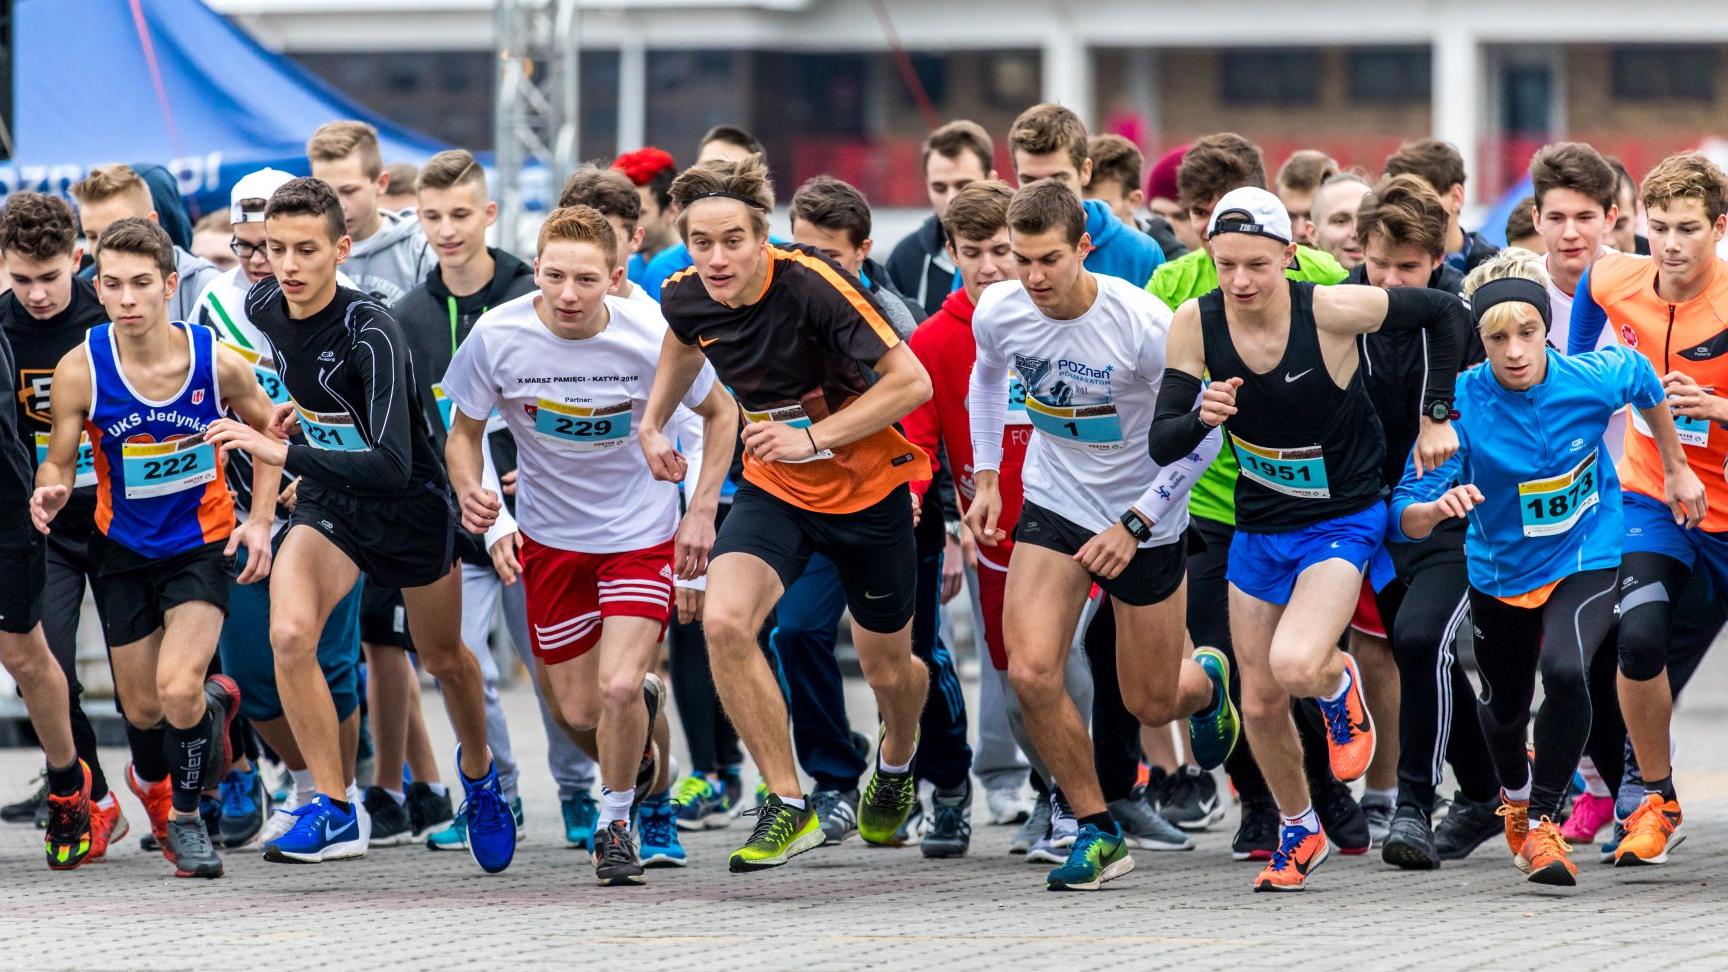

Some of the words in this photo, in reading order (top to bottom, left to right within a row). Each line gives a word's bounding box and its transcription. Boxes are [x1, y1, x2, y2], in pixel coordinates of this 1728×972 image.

[553, 376, 586, 384] PAMIĘCI
[108, 412, 142, 437] UKS
[555, 418, 612, 436] 229
[1063, 421, 1079, 437] 1
[143, 453, 198, 480] 222
[1246, 456, 1311, 482] 1951
[1527, 472, 1594, 519] 1873
[180, 738, 207, 790] Kalenji
